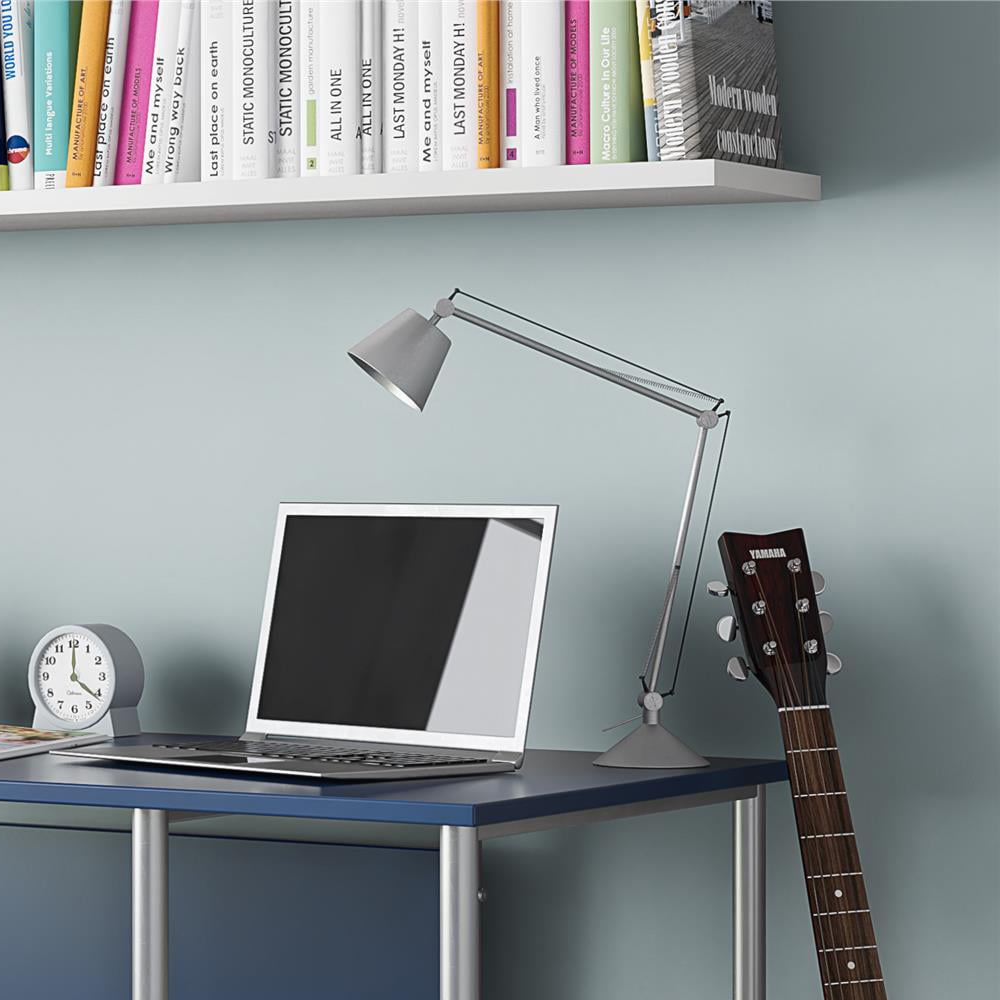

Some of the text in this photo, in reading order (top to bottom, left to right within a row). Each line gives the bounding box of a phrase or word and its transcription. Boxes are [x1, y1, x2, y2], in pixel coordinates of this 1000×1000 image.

[1, 0, 16, 80] WORLD YOU LO
[601, 27, 609, 45] Life
[45, 52, 53, 96] Variations
[174, 48, 185, 85] back
[280, 0, 292, 136] STATIC MONOCULT
[393, 46, 405, 104] MONDAY
[422, 40, 432, 92] myself
[454, 41, 465, 99] MONDAY
[570, 58, 576, 69] OF
[602, 70, 609, 80] In
[101, 80, 110, 97] on
[152, 57, 165, 107] myself
[362, 58, 372, 136] ALL IN ONE
[652, 34, 686, 160] Modern wooden
[708, 74, 777, 116] Modern wooden
[45, 100, 56, 130] langue
[126, 68, 141, 163] MANUFACTURE OF MODELS
[171, 91, 183, 120] way
[209, 41, 220, 176] Last place on earth
[331, 69, 341, 141] ALL IN ONE
[601, 83, 610, 122] Culture
[72, 98, 83, 160] MANUFACTURE
[78, 86, 84, 96] OF
[96, 103, 108, 144] place
[149, 114, 158, 144] and
[243, 102, 254, 144] STATIC
[393, 108, 405, 139] LAST
[454, 103, 465, 135] LAST
[165, 127, 179, 173] Wrong
[423, 136, 431, 162] Me
[602, 125, 610, 160] Macro
[717, 128, 776, 160] constructions
[94, 150, 104, 177] Last
[145, 149, 155, 174] Me
[749, 548, 786, 559] YAMAHA
[68, 639, 80, 648] 12
[42, 672, 49, 681] 9
[45, 656, 56, 665] 10
[95, 656, 102, 665] 2
[99, 672, 106, 681] 3
[47, 688, 54, 697] 8
[58, 701, 64, 709] 7
[85, 701, 92, 710] 5
[72, 705, 78, 713] 6
